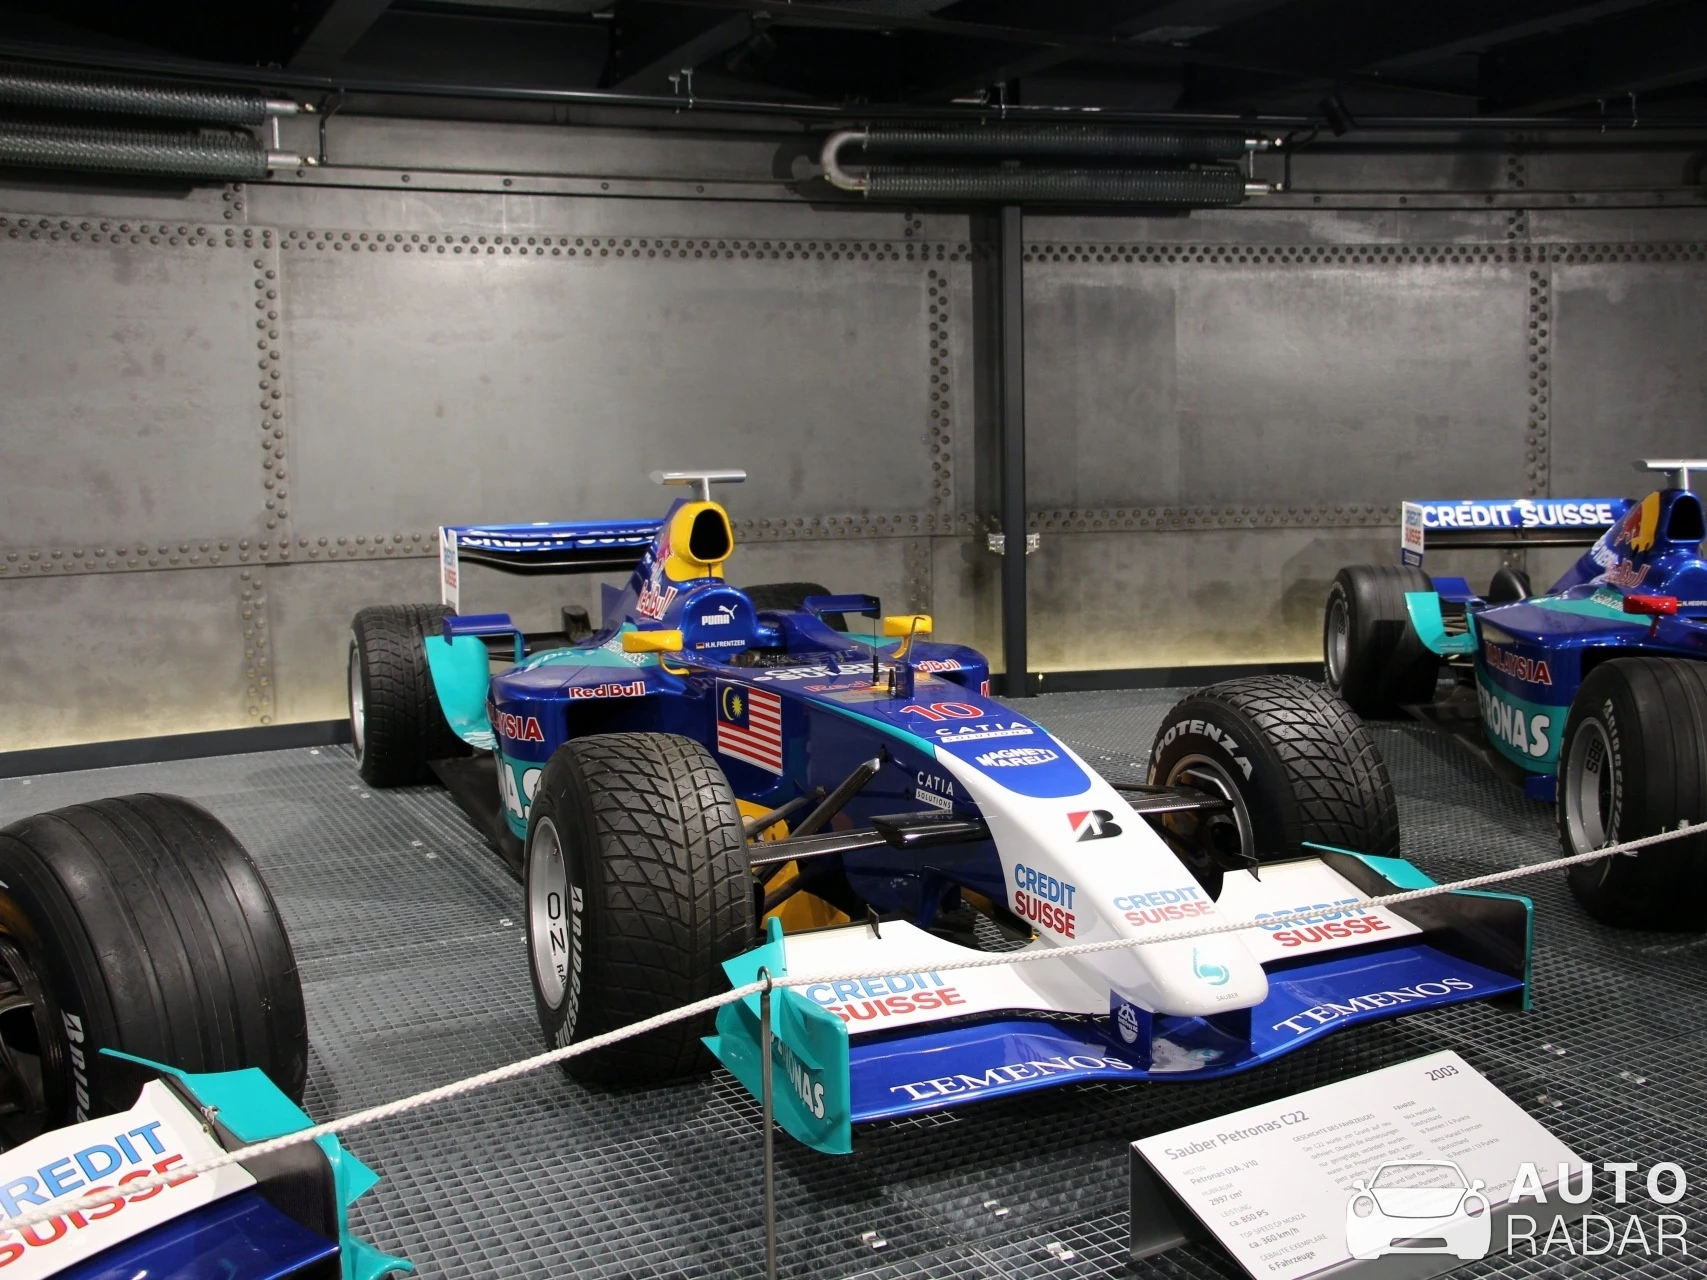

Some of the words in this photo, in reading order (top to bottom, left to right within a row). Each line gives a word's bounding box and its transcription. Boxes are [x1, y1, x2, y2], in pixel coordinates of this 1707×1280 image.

[1423, 505, 1512, 528] CREDIT
[1520, 503, 1615, 527] SUISSE
[702, 614, 730, 626] PUMA
[930, 659, 962, 673] Bull
[569, 684, 607, 699] Red
[607, 681, 645, 698] Bull
[903, 702, 984, 721] 10
[935, 722, 1028, 736] CATIA
[945, 729, 1030, 742] SOLUTIONS
[1155, 719, 1253, 781] POTENZA
[1586, 738, 1605, 774] BBS
[917, 771, 953, 797] CATIA
[916, 789, 952, 809] SOLUTIONS
[1014, 863, 1076, 910] CREDIT
[1113, 886, 1200, 911] CREDIT
[1014, 889, 1076, 939] SUISSE
[1124, 900, 1216, 928] SUISSE
[1272, 915, 1392, 947] SUISSE
[806, 969, 945, 1006] CREDIT
[1215, 992, 1240, 1002] SAUBER
[826, 987, 967, 1024] SUISSE
[1272, 978, 1474, 1035] TEMENOS
[889, 1054, 1134, 1101] TEMENOS
[1425, 1064, 1459, 1082] 2003
[1165, 1139, 1218, 1160] Sauber
[1216, 1119, 1282, 1146] Petronas
[1280, 1110, 1309, 1126] C22
[0, 1121, 166, 1222] REDIT
[1190, 1169, 1226, 1185] Petronas
[1224, 1164, 1244, 1176] 03A,
[1242, 1159, 1259, 1169] V10
[1209, 1194, 1229, 1206] 2997
[1220, 1204, 1252, 1218] LEISTUNG
[1229, 1219, 1241, 1227] ca.
[1241, 1213, 1256, 1224] 850
[1256, 1209, 1269, 1218] PS
[1240, 1229, 1254, 1240] TOP
[1253, 1223, 1273, 1236] SPEED
[1282, 1212, 1307, 1225] MONZA
[1249, 1240, 1262, 1249] ca.
[1261, 1234, 1277, 1246] 360
[1277, 1226, 1300, 1239] km/h
[1259, 1246, 1290, 1262] GEBAUTE
[1288, 1233, 1328, 1251] EXEMPLARE
[1268, 1263, 1277, 1272] 6
[1275, 1250, 1317, 1270] Fahrzeuge
